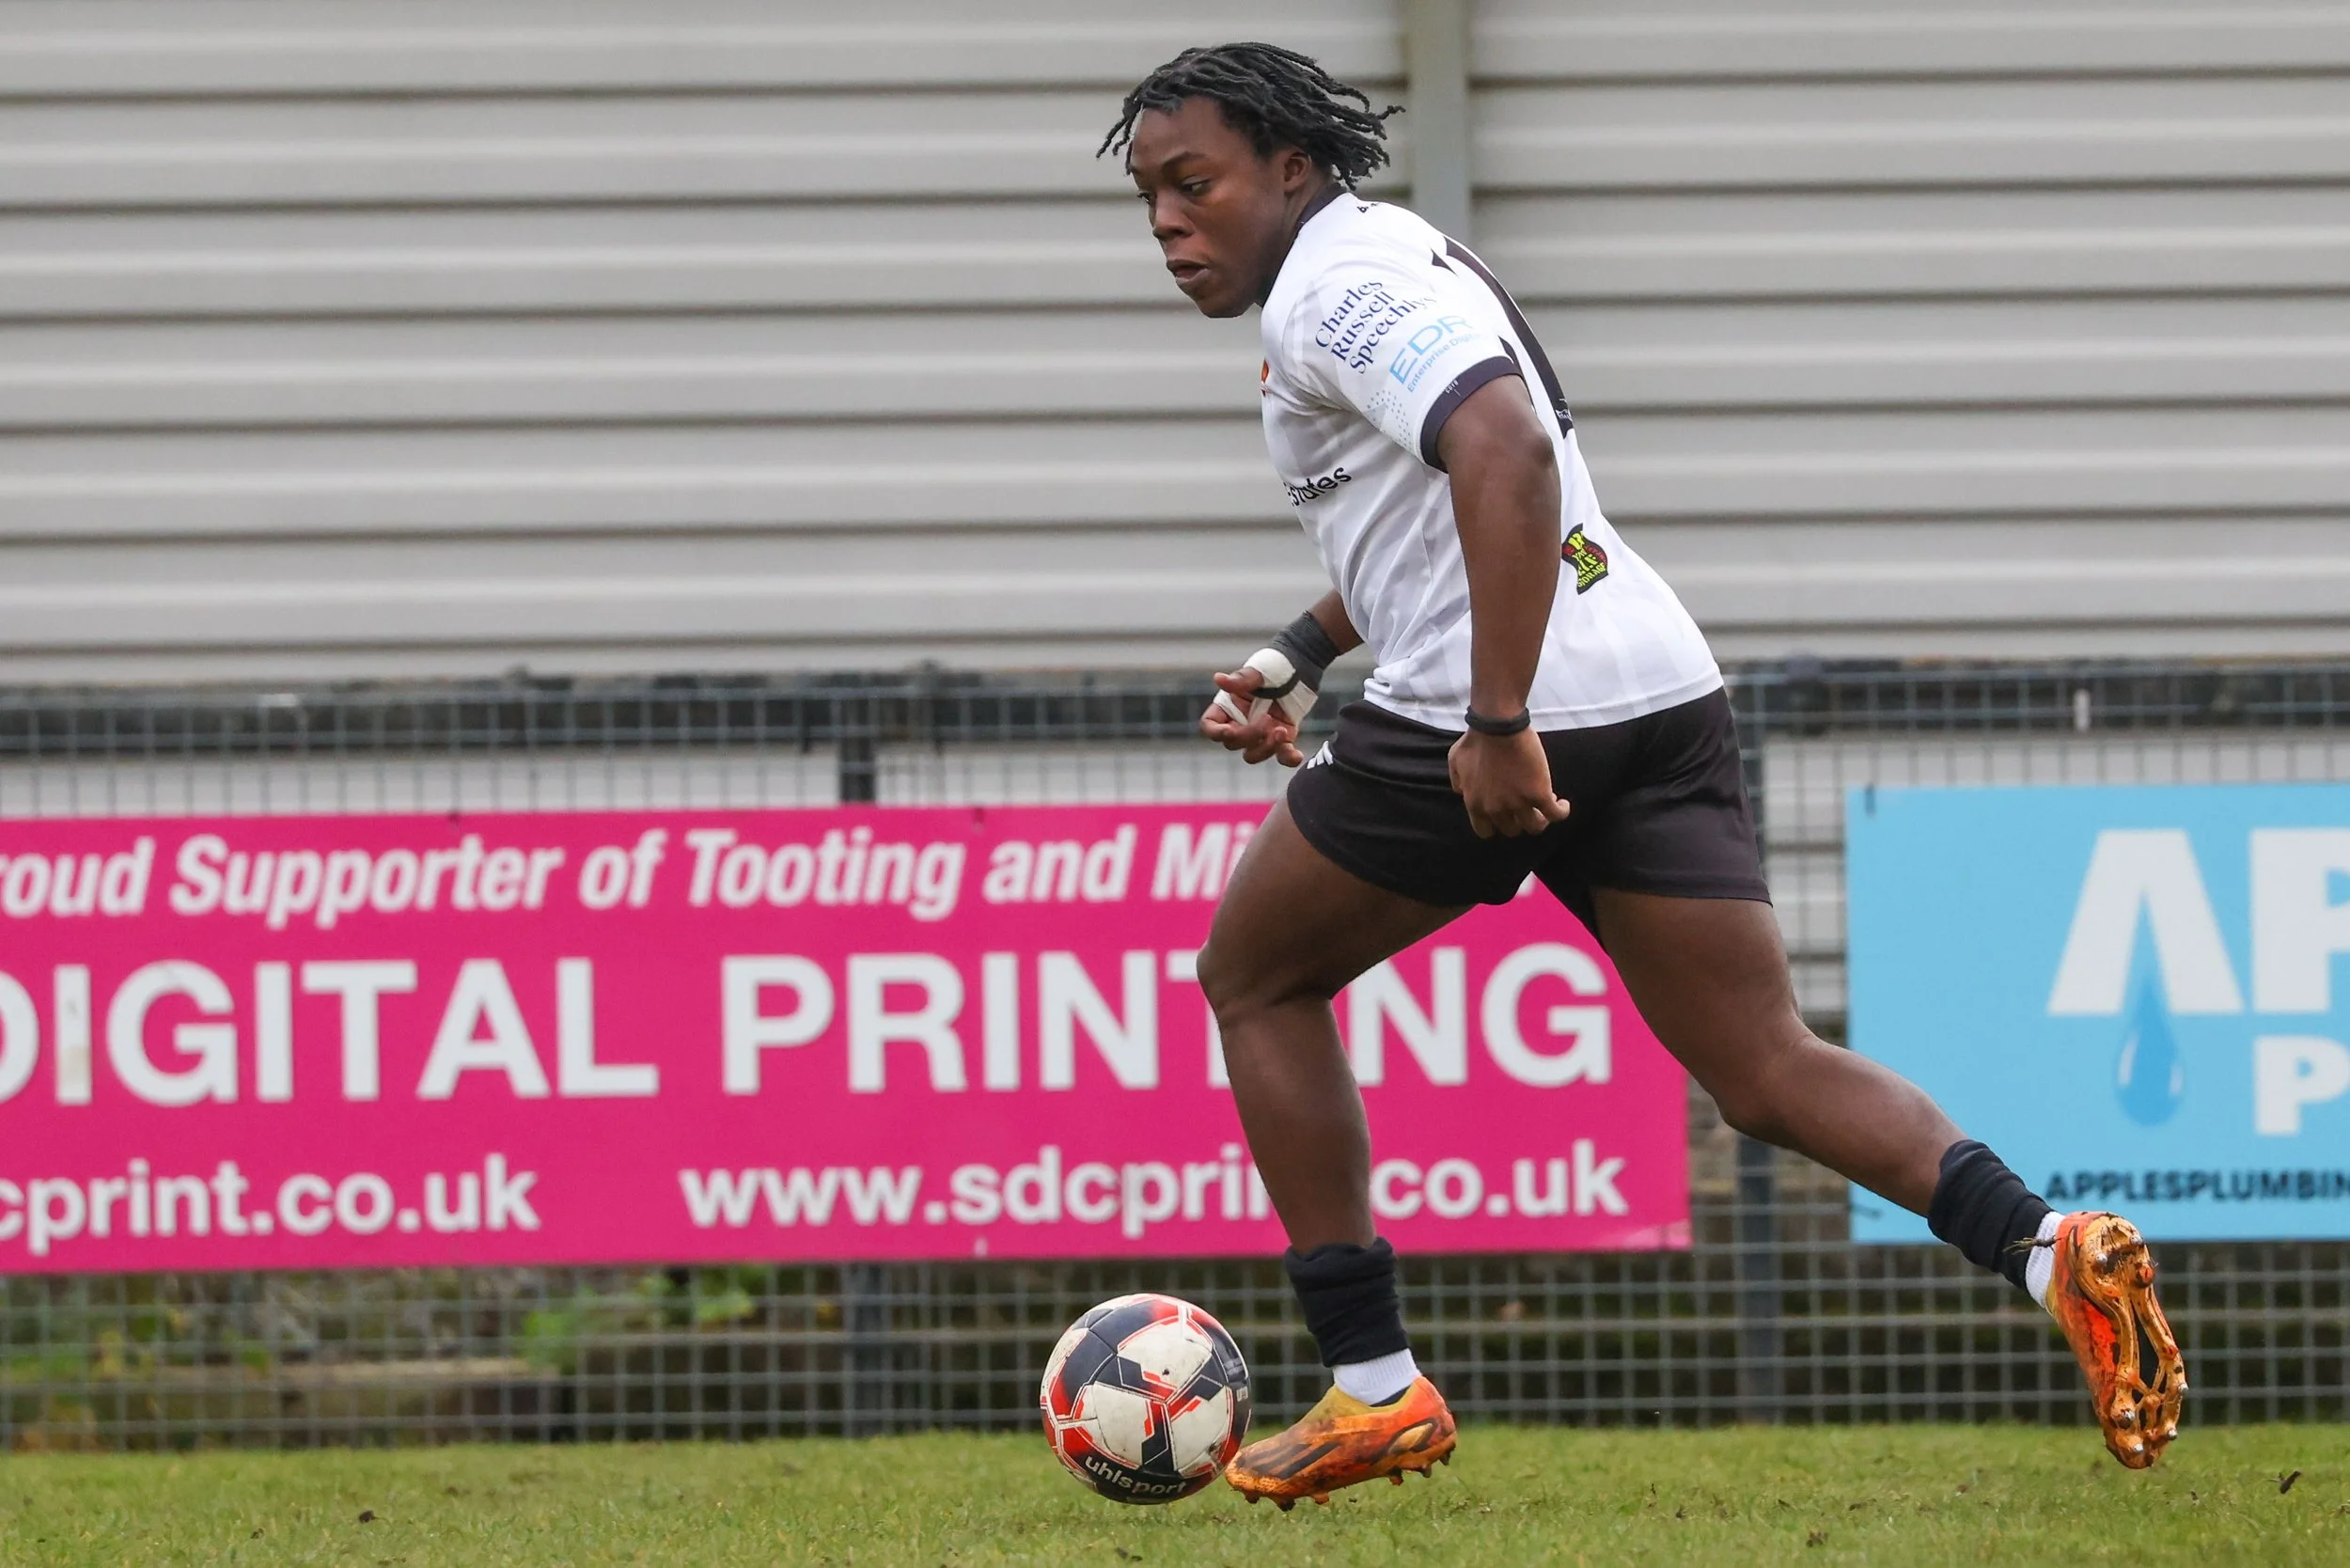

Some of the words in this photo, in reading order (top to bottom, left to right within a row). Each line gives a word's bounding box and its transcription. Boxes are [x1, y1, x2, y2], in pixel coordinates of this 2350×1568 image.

[1315, 281, 1383, 348] Charles
[1330, 290, 1395, 361] Russell
[1389, 315, 1473, 384] EDR
[1406, 344, 1450, 393] Enterprise
[1283, 467, 1352, 507] states
[0, 835, 156, 917] oud
[170, 834, 565, 930] Supporter
[579, 829, 667, 909] of
[685, 827, 967, 922] Tooting
[983, 824, 1137, 903] and
[1150, 822, 1256, 901] Mi
[721, 943, 1611, 1095] PRINNG
[680, 1138, 1628, 1238] www.sdcprico.uk
[1085, 1455, 1186, 1494] uhlsport
